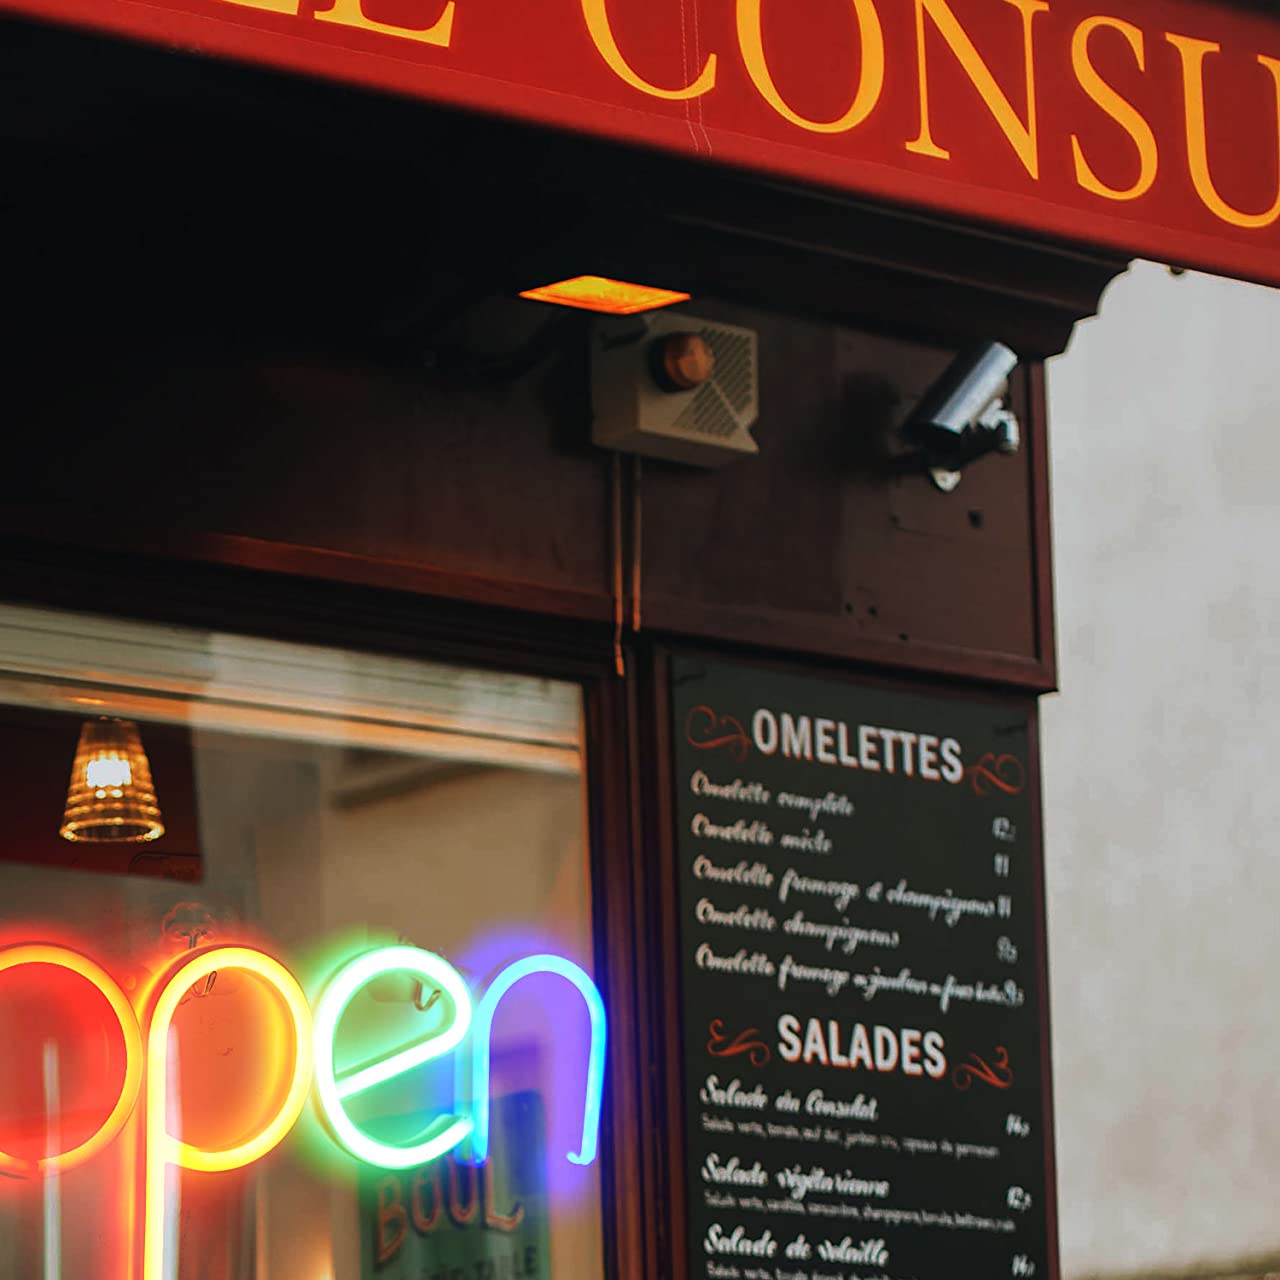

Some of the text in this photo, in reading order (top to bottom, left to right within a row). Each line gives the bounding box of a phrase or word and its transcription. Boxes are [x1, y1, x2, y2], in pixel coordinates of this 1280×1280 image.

[752, 708, 965, 784] OMELETTES
[777, 1014, 947, 1079] SALADES
[700, 1074, 768, 1109] Salade
[701, 1152, 768, 1186] Salade
[704, 1223, 777, 1257] Salade
